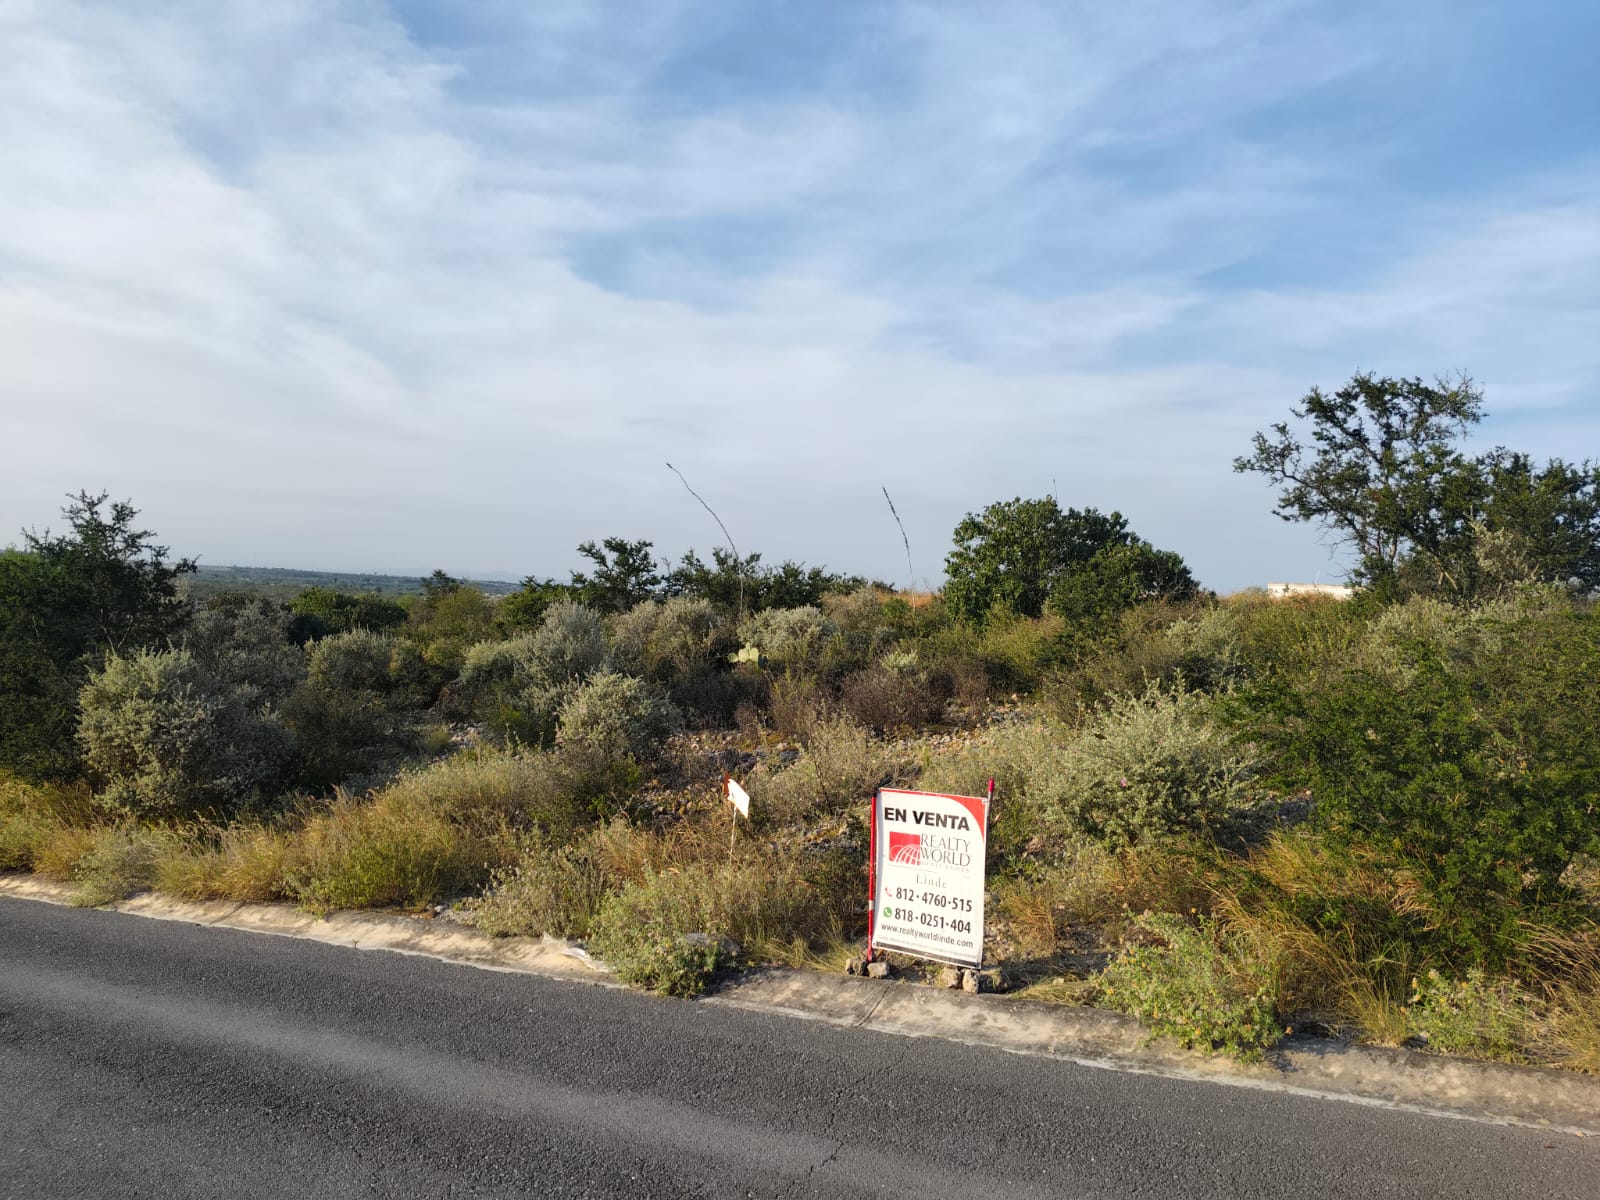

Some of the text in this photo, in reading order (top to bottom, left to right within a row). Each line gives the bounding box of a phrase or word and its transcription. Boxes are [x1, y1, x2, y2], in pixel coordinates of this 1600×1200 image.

[884, 807, 970, 831] EN VENTA
[920, 833, 971, 853] REALTY
[920, 847, 971, 867] WORLD
[881, 923, 974, 949] www.realtyworldlinde.com
